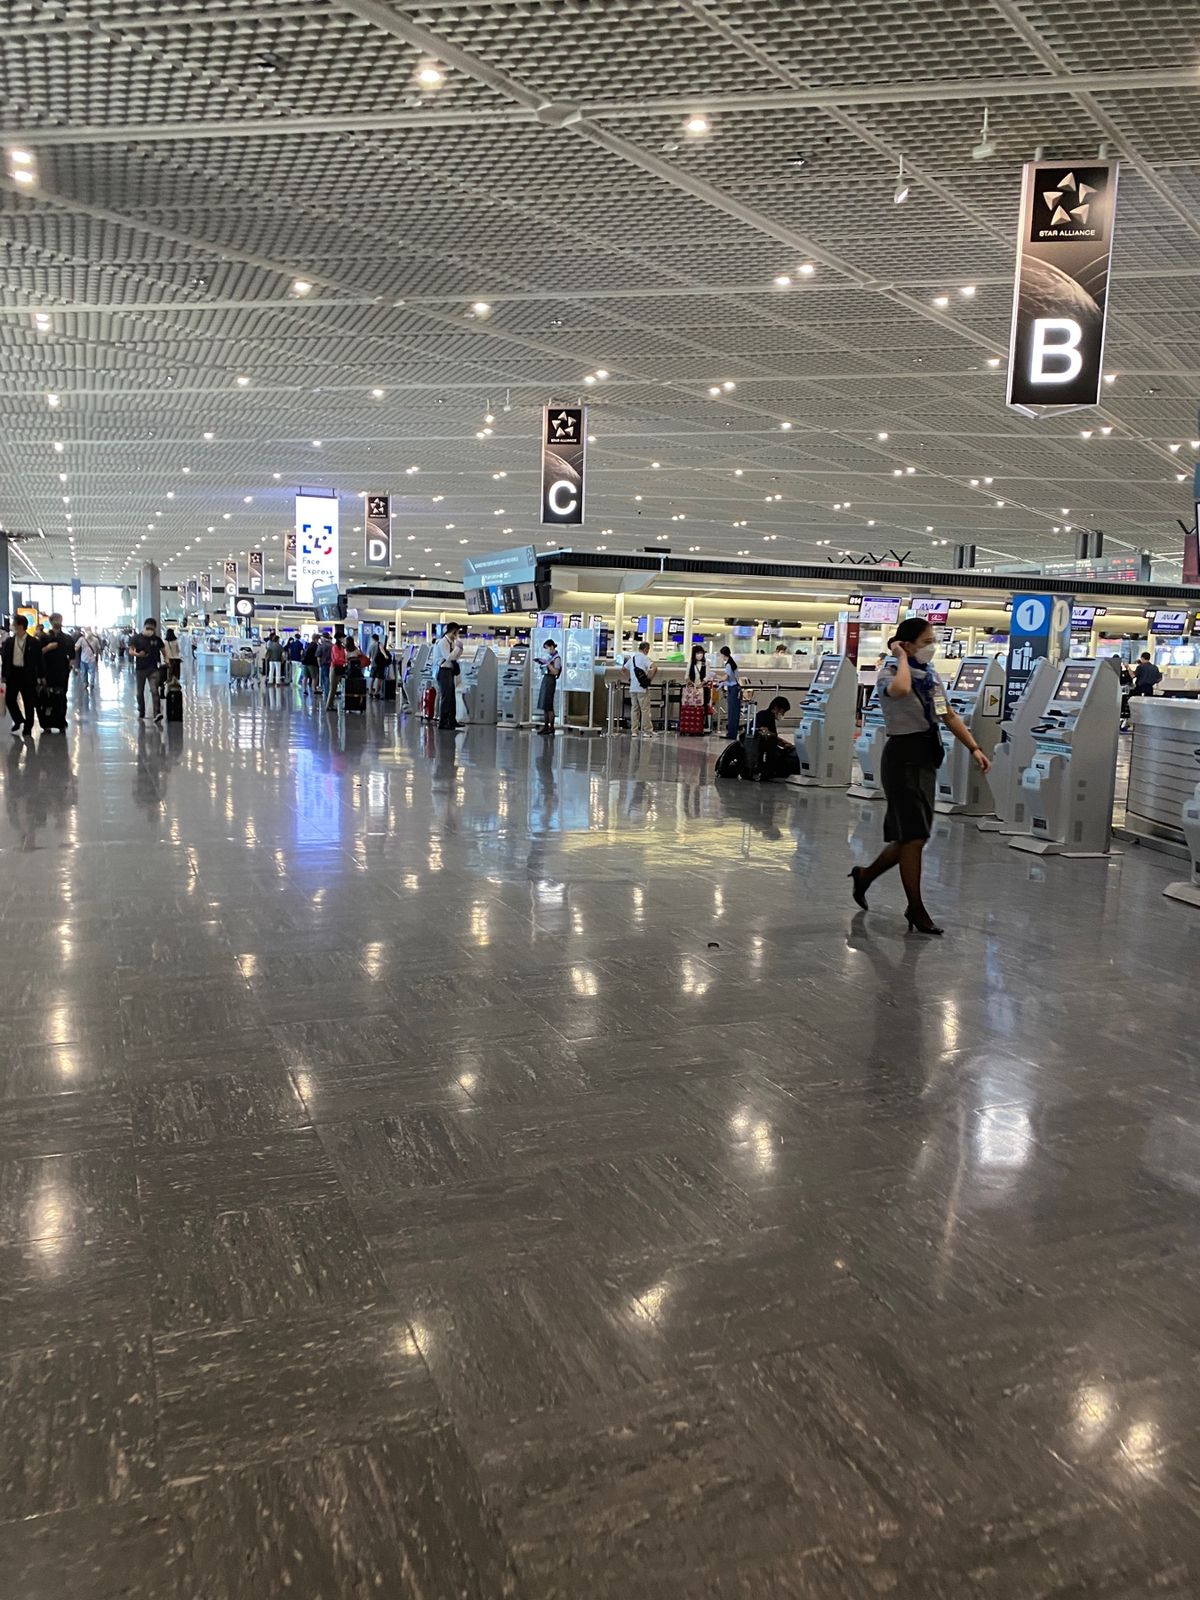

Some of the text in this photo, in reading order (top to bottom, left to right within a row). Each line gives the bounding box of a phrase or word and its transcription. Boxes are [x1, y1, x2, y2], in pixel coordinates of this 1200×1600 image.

[1059, 229, 1096, 237] ALLIANCE
[1030, 318, 1083, 385] B
[549, 480, 577, 515] C
[369, 539, 387, 561] D
[302, 557, 321, 565] Face
[302, 568, 333, 576] Express
[226, 583, 237, 595] G
[251, 577, 261, 591] F
[202, 591, 210, 602] H
[1026, 604, 1035, 625] 1
[1058, 606, 1063, 626] 1
